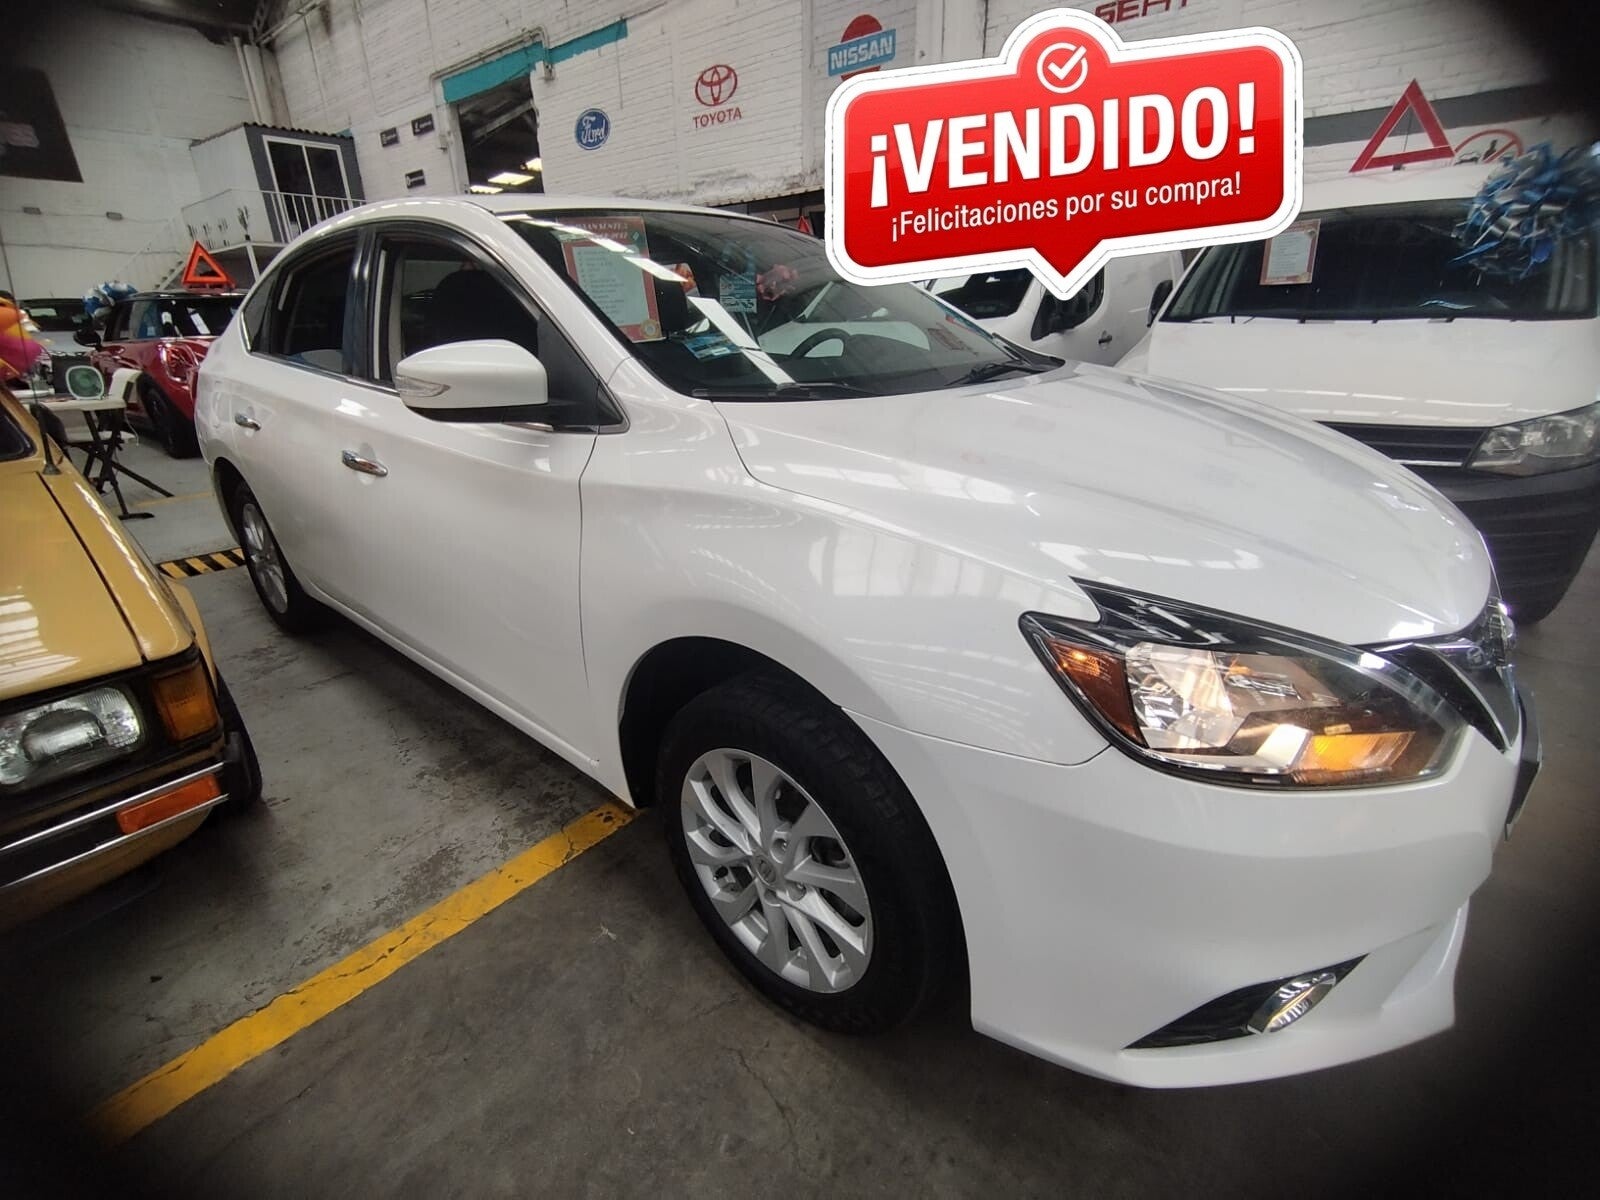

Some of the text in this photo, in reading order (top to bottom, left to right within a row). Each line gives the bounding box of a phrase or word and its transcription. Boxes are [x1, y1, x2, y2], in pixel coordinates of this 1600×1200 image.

[830, 35, 893, 70] NISSAN
[582, 116, 606, 144] Ford
[693, 107, 742, 128] TOYOTA
